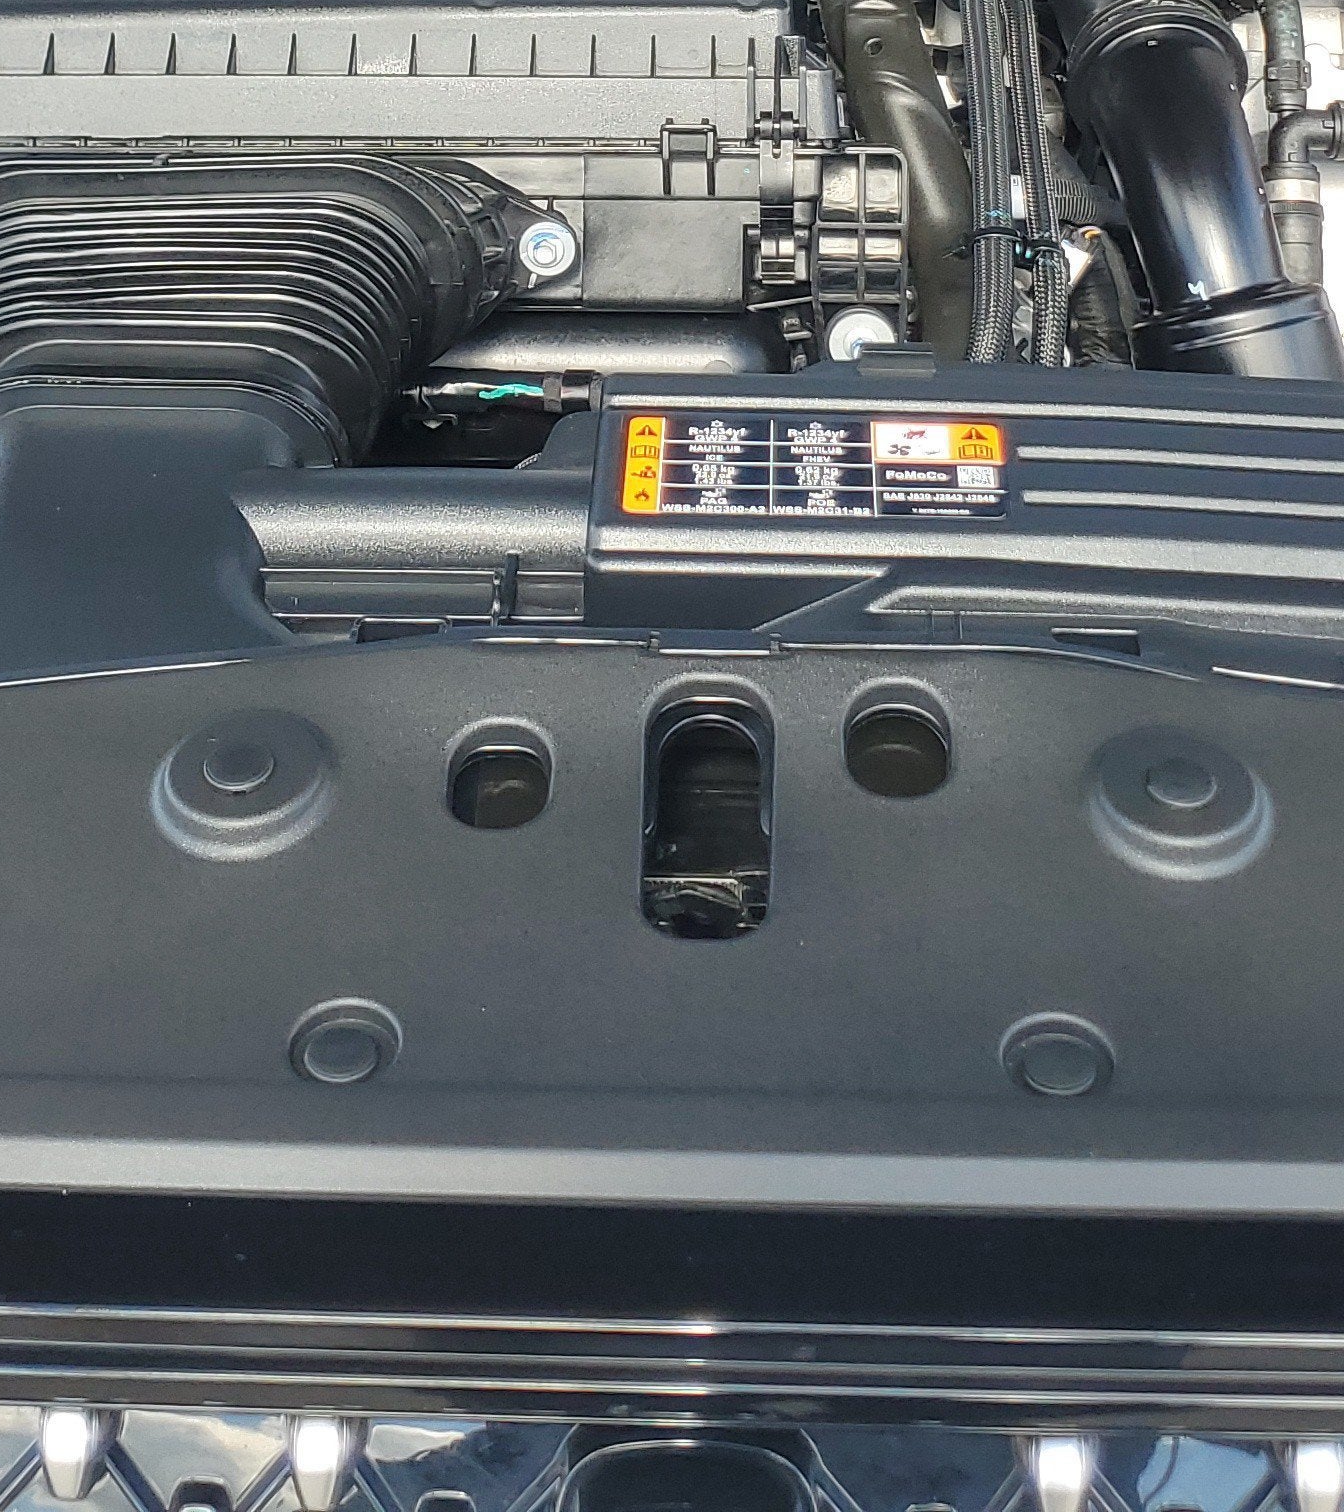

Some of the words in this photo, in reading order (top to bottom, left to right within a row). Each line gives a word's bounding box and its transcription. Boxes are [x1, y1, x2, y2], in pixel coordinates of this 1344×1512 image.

[689, 426, 746, 437] R-1234yf
[787, 428, 846, 438] R-1234yf
[689, 444, 741, 453] NAUTILUS
[791, 446, 843, 454] NAUTILUS
[885, 469, 947, 481] FoMoCo
[700, 497, 728, 505] PAG
[883, 492, 905, 501] SAE
